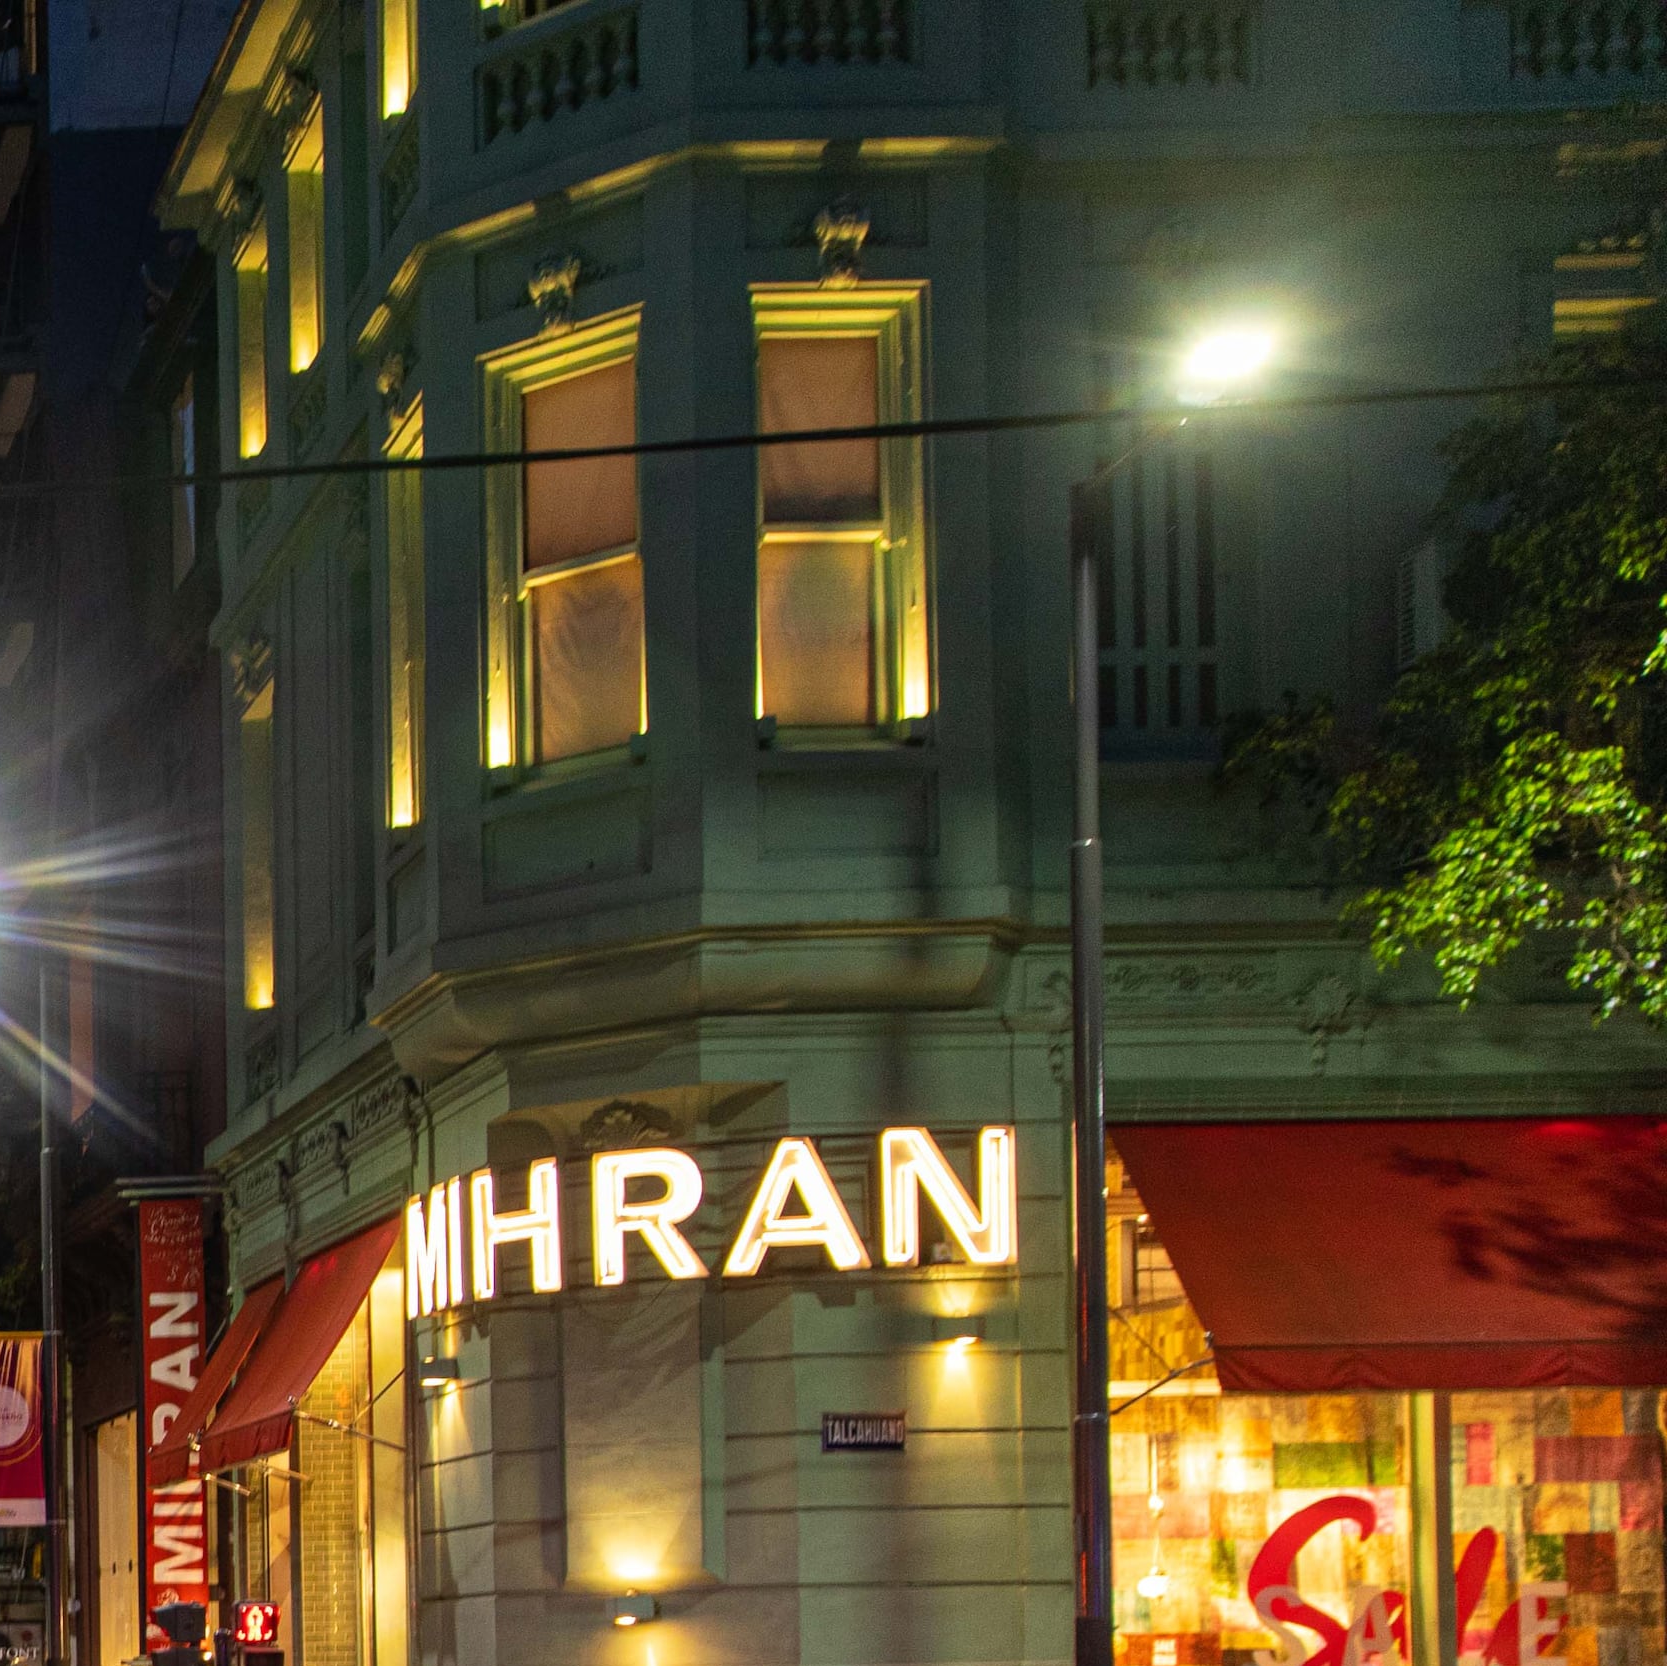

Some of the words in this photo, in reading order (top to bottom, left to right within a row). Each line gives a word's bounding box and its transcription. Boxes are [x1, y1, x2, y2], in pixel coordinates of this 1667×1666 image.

[405, 1126, 1016, 1320] MIHRAN
[149, 1292, 204, 1584] MIAN
[827, 1419, 904, 1444] TALCAHUANO
